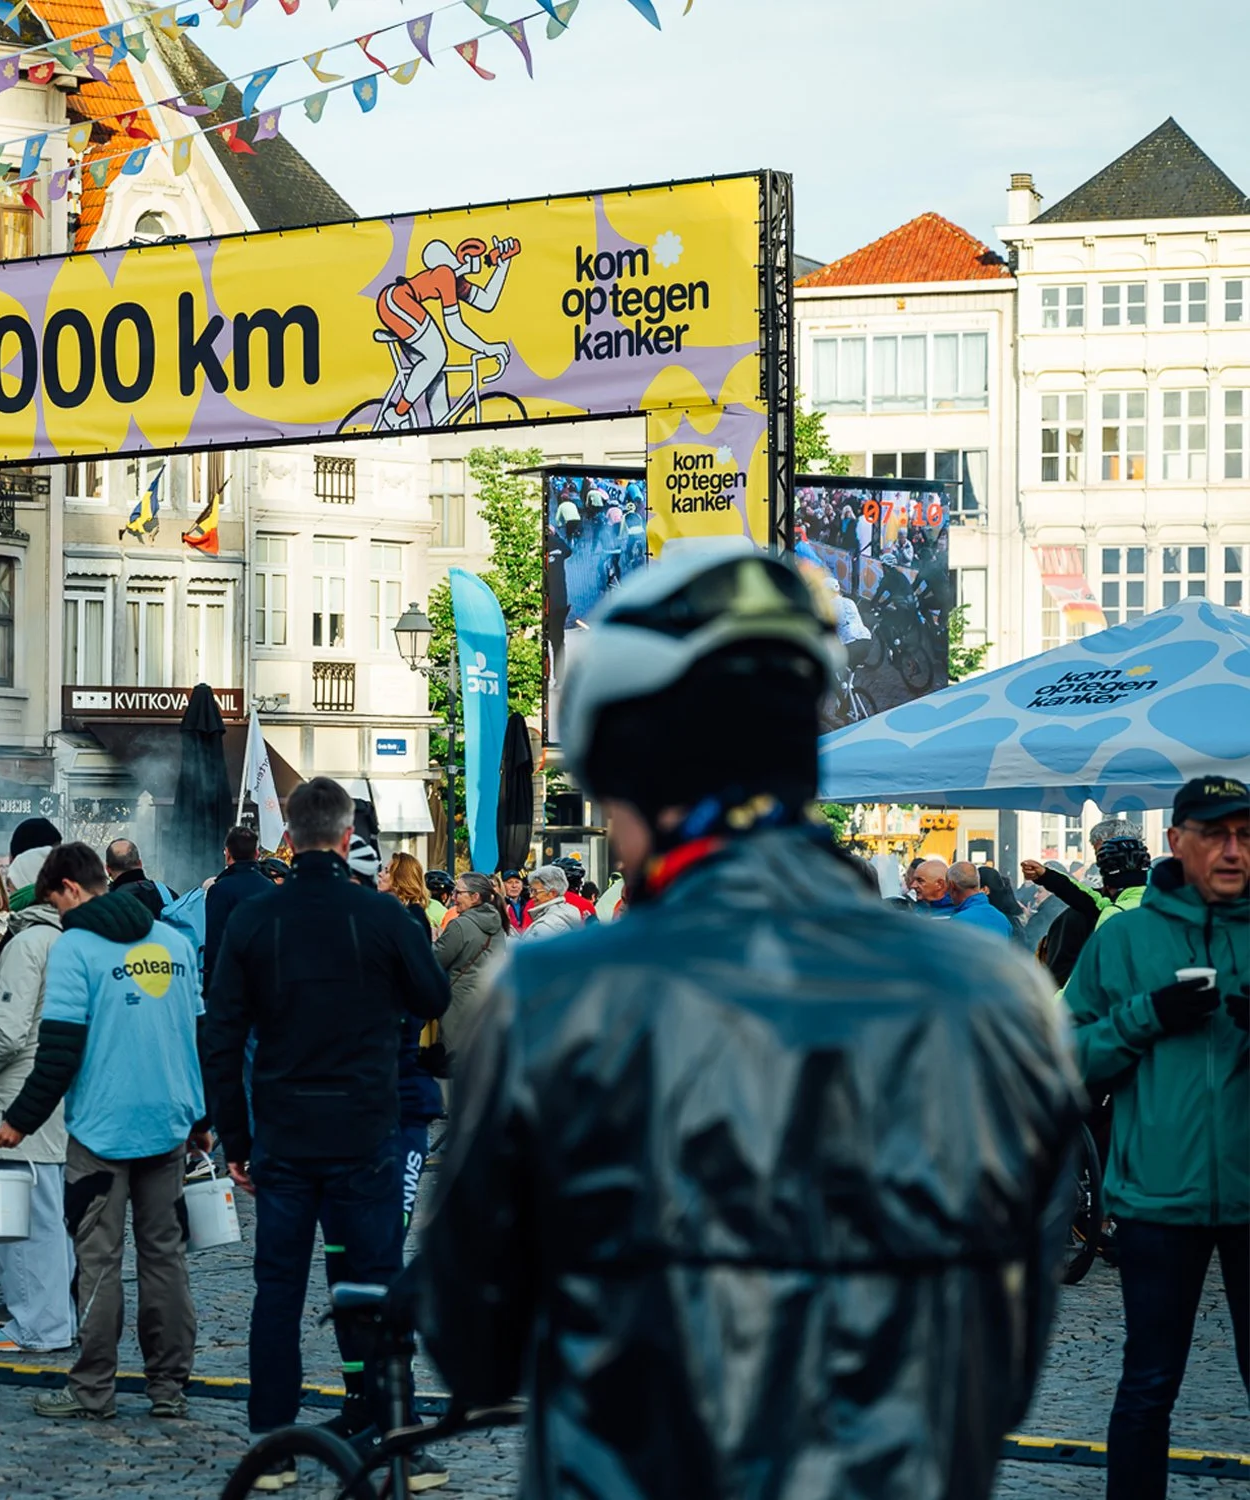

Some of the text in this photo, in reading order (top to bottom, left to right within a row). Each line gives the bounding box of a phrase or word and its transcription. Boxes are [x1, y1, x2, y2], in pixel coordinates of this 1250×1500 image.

[575, 245, 649, 283] kom
[561, 280, 710, 326] op tegen
[177, 291, 321, 397] km
[574, 318, 690, 362] kanker
[673, 451, 714, 472] kom
[666, 471, 748, 495] op tegen
[671, 491, 735, 514] kanker
[862, 499, 943, 528] 07:10
[1057, 669, 1123, 684] kom
[1034, 680, 1159, 697] op tegen
[1026, 692, 1129, 709] kanker
[112, 958, 185, 981] ecoteam
